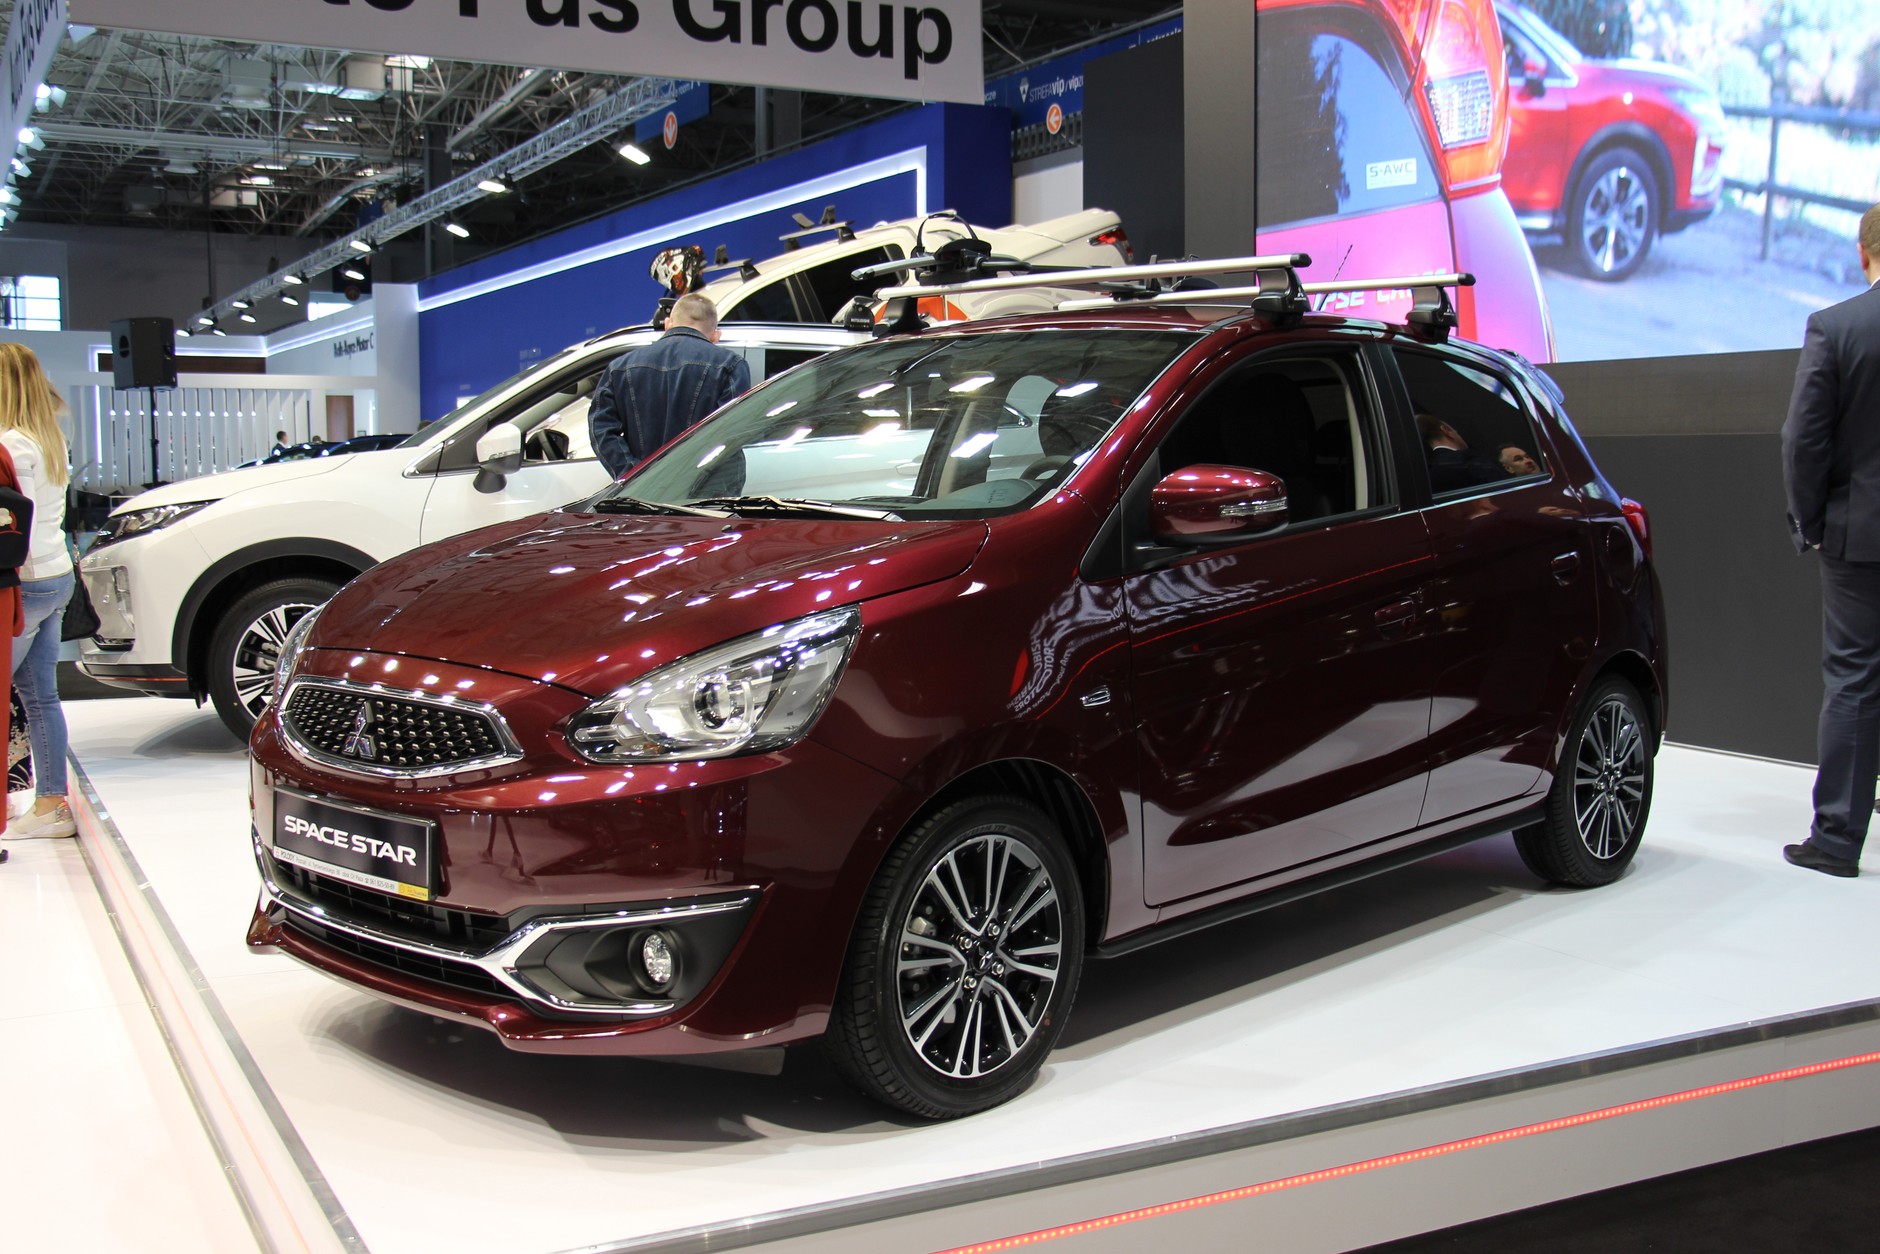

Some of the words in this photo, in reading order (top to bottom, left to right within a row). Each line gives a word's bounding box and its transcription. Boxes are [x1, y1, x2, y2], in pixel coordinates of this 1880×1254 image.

[672, 0, 953, 80] Group
[1369, 161, 1414, 178] S-AWC
[1312, 288, 1365, 312] IPSE
[284, 814, 350, 849] SPACE
[351, 834, 417, 867] STAR
